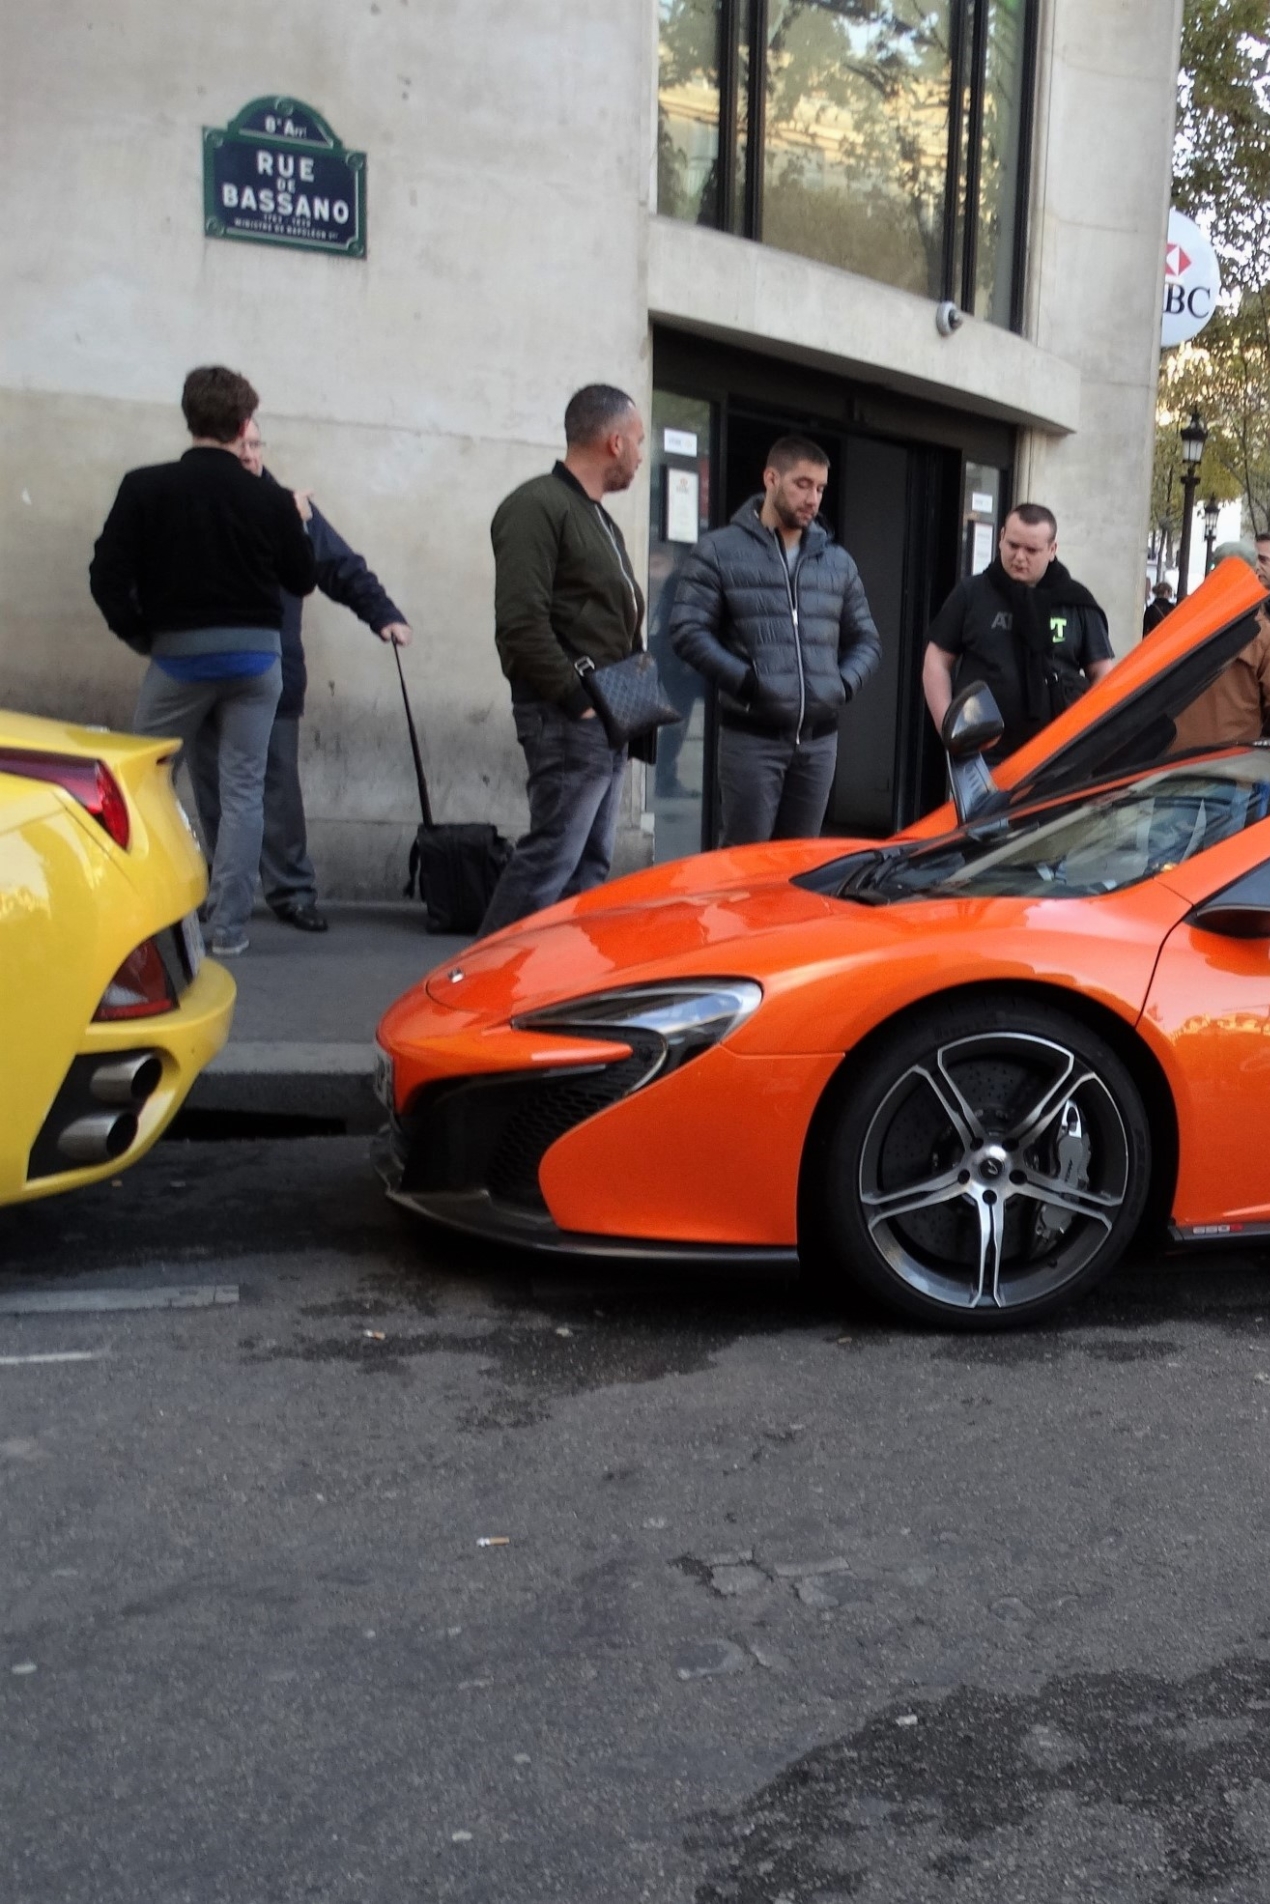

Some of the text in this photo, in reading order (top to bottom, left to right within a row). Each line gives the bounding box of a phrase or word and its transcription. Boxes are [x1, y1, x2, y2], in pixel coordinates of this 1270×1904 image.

[257, 151, 315, 182] RUE
[277, 178, 296, 193] DE
[223, 183, 349, 224] BASSANO
